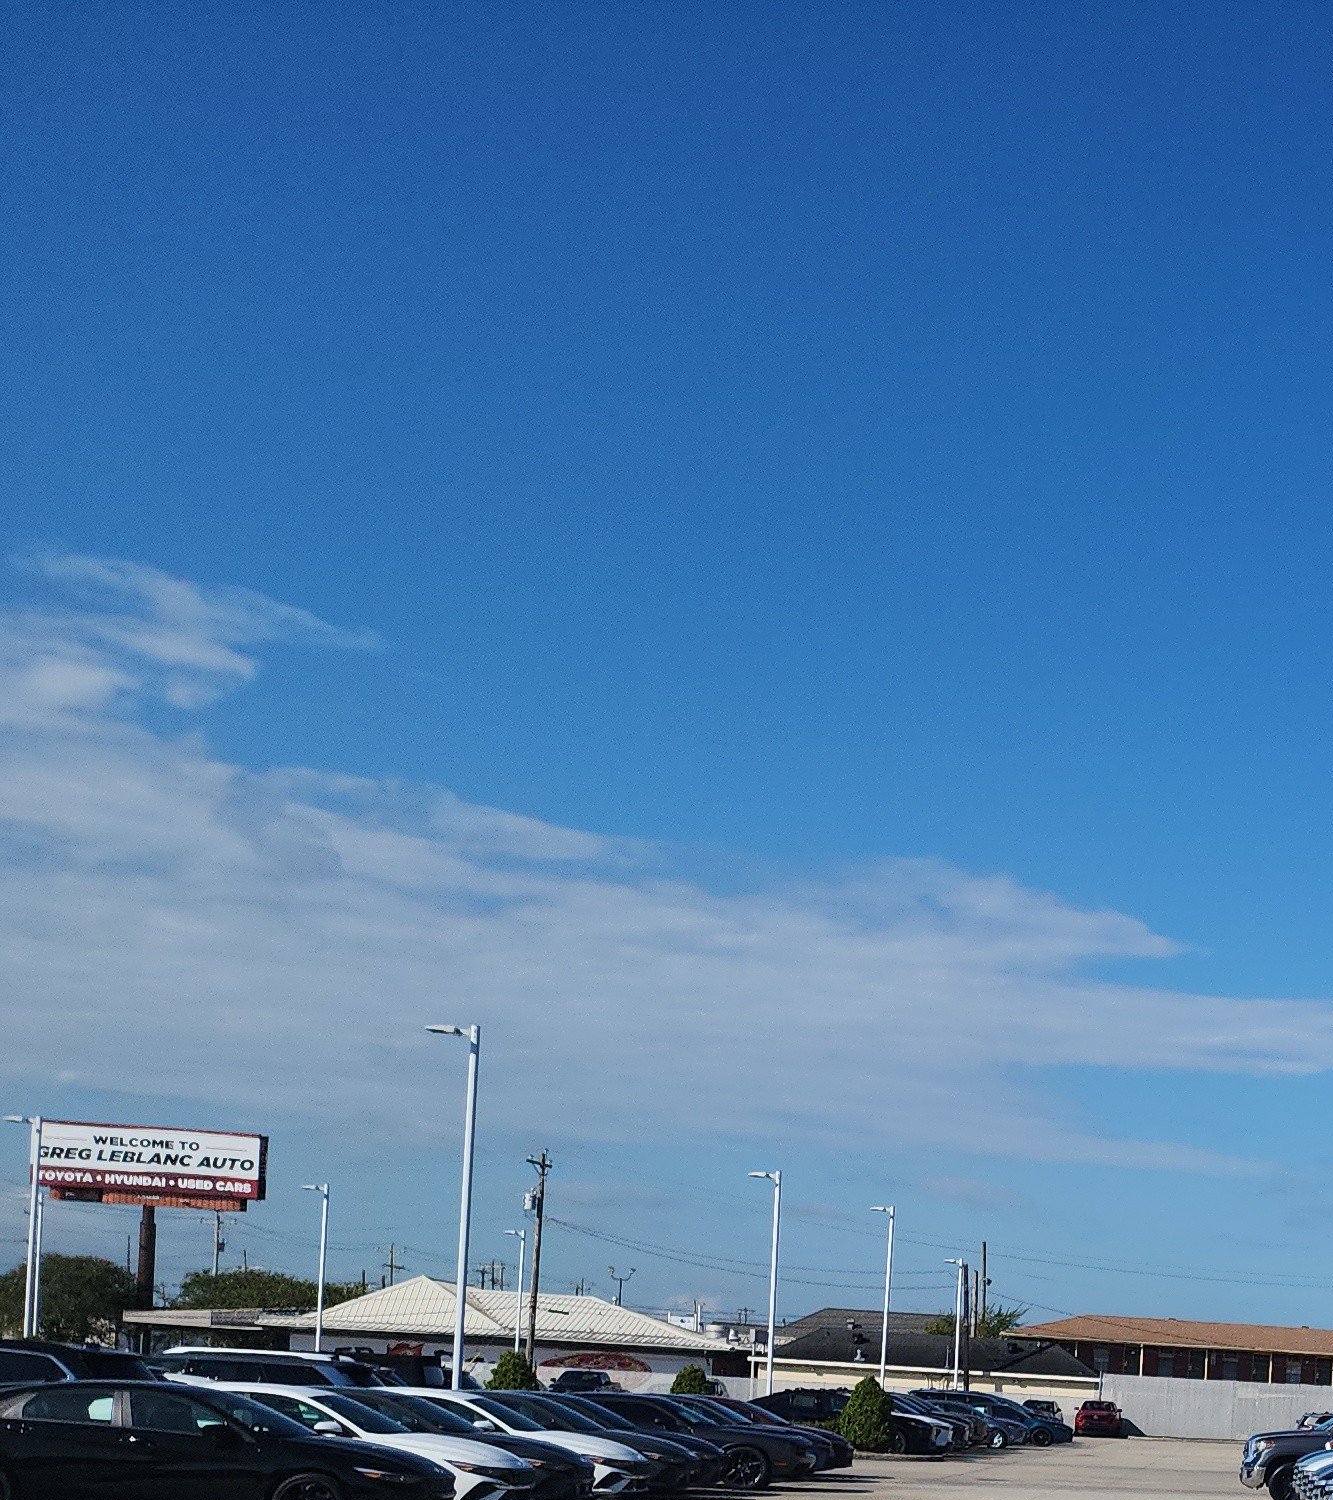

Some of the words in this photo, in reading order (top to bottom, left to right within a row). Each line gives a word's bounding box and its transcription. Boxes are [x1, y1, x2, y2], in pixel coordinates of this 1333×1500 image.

[93, 1135, 174, 1150] WELCOME
[178, 1141, 200, 1152] TO
[40, 1146, 92, 1160] GREG
[97, 1149, 193, 1167] LEBLANC
[197, 1156, 254, 1171] AUTO
[105, 1173, 166, 1187] HYUNDAI
[178, 1178, 213, 1190] USED
[216, 1182, 252, 1193] CARS
